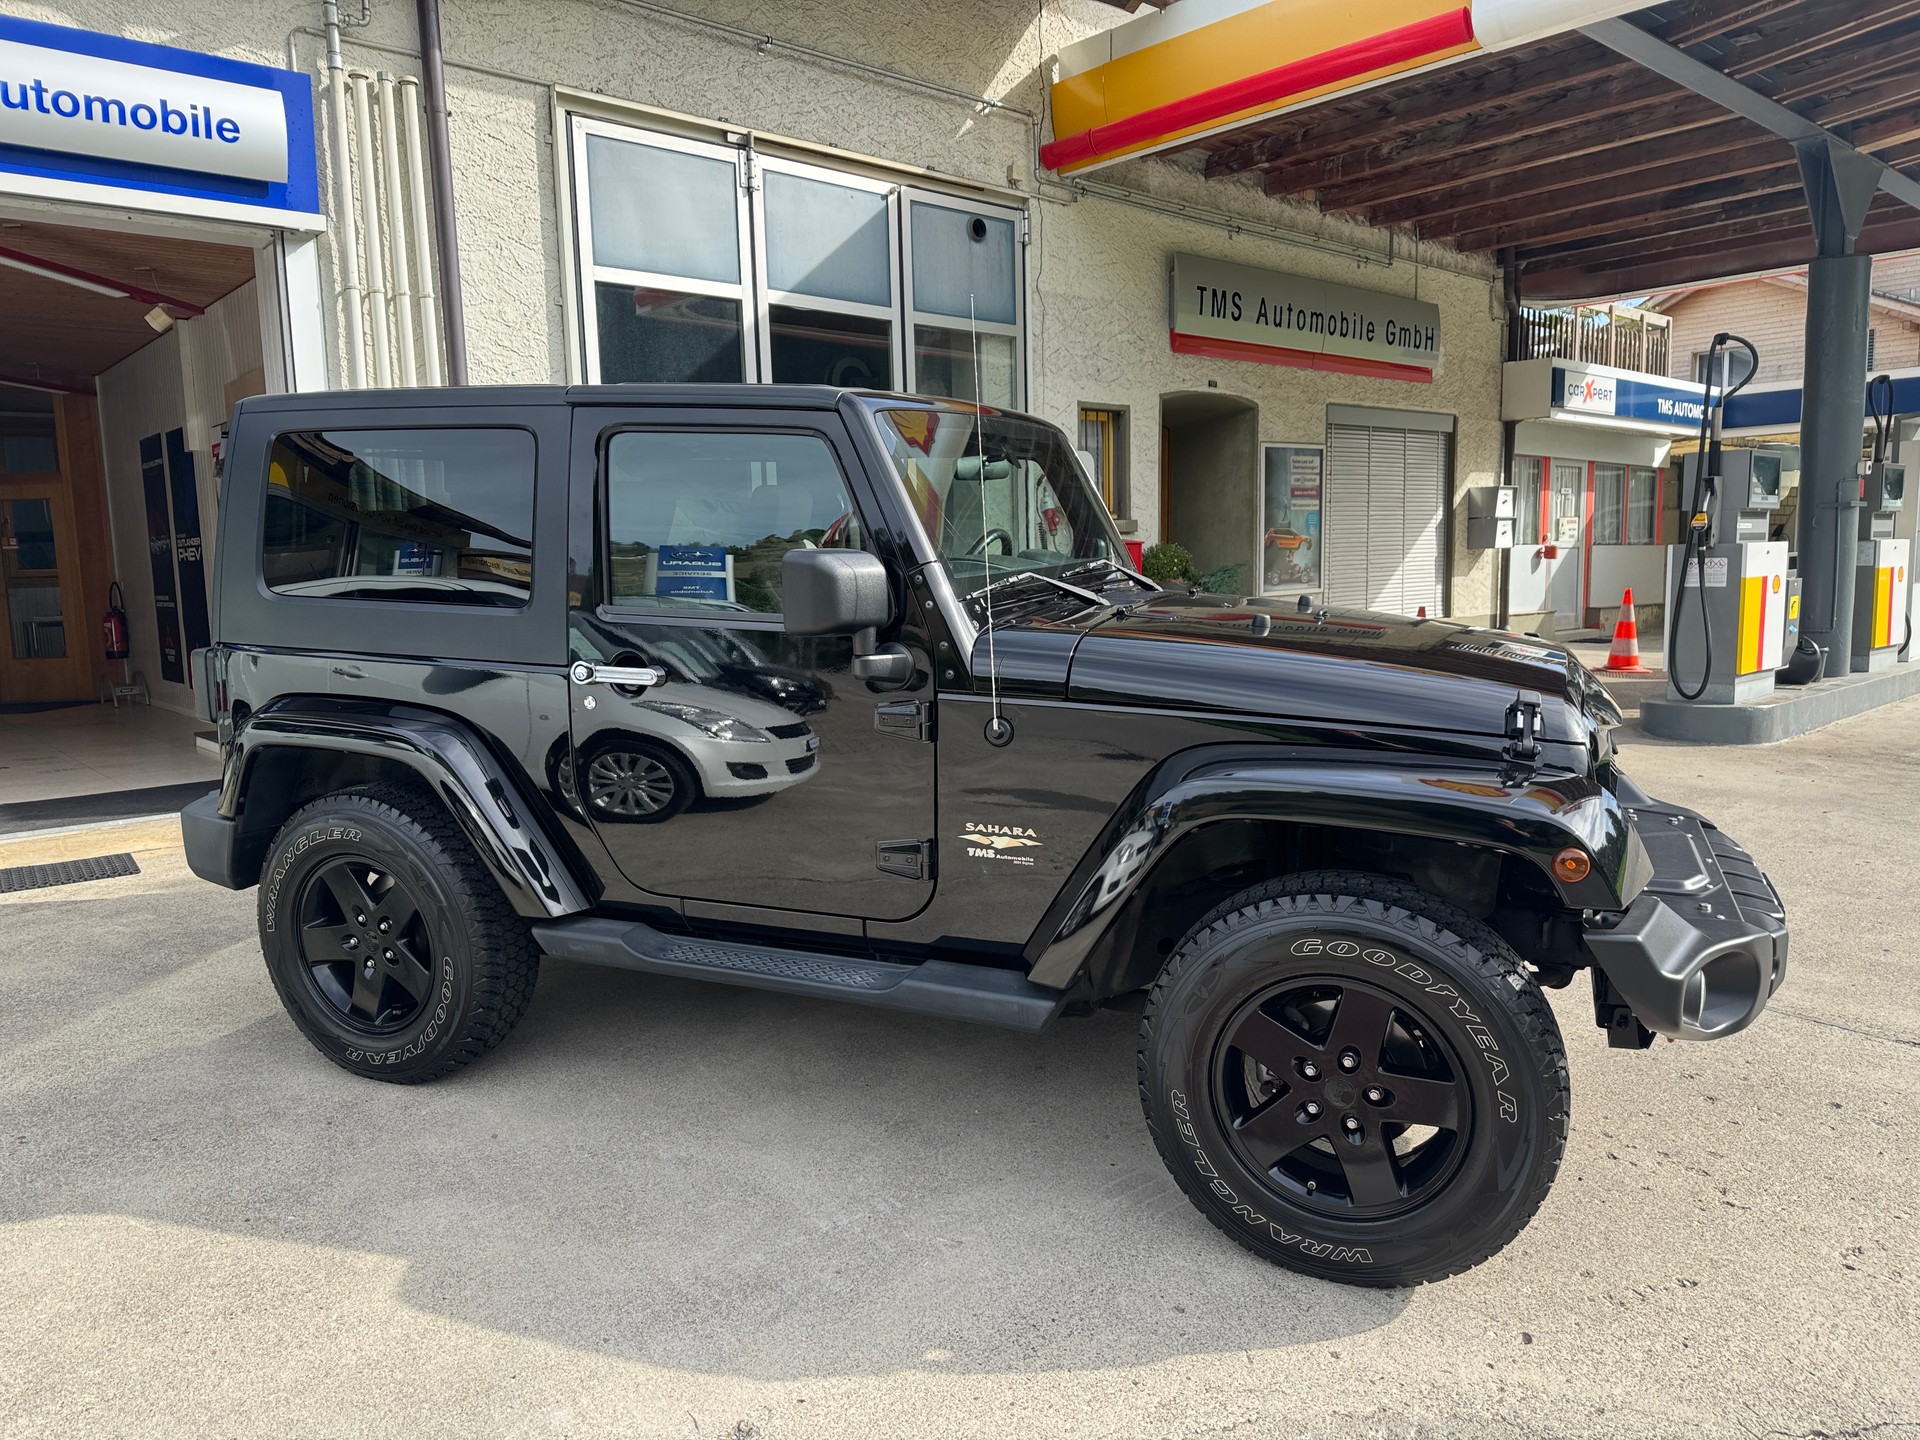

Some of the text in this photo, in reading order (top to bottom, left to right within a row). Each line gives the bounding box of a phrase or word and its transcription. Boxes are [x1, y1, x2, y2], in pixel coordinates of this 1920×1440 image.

[1196, 285, 1435, 352] TMS Automobile GmbH
[1657, 398, 1673, 415] TMS
[177, 546, 201, 561] PHEV
[965, 822, 1037, 838] SAHARA
[966, 847, 996, 858] TMS
[266, 827, 363, 932] WRANGLER
[345, 956, 455, 1065] GOODYEAR
[1290, 938, 1518, 1124] GOODYEAR
[1171, 1089, 1373, 1263] WRANGLER
